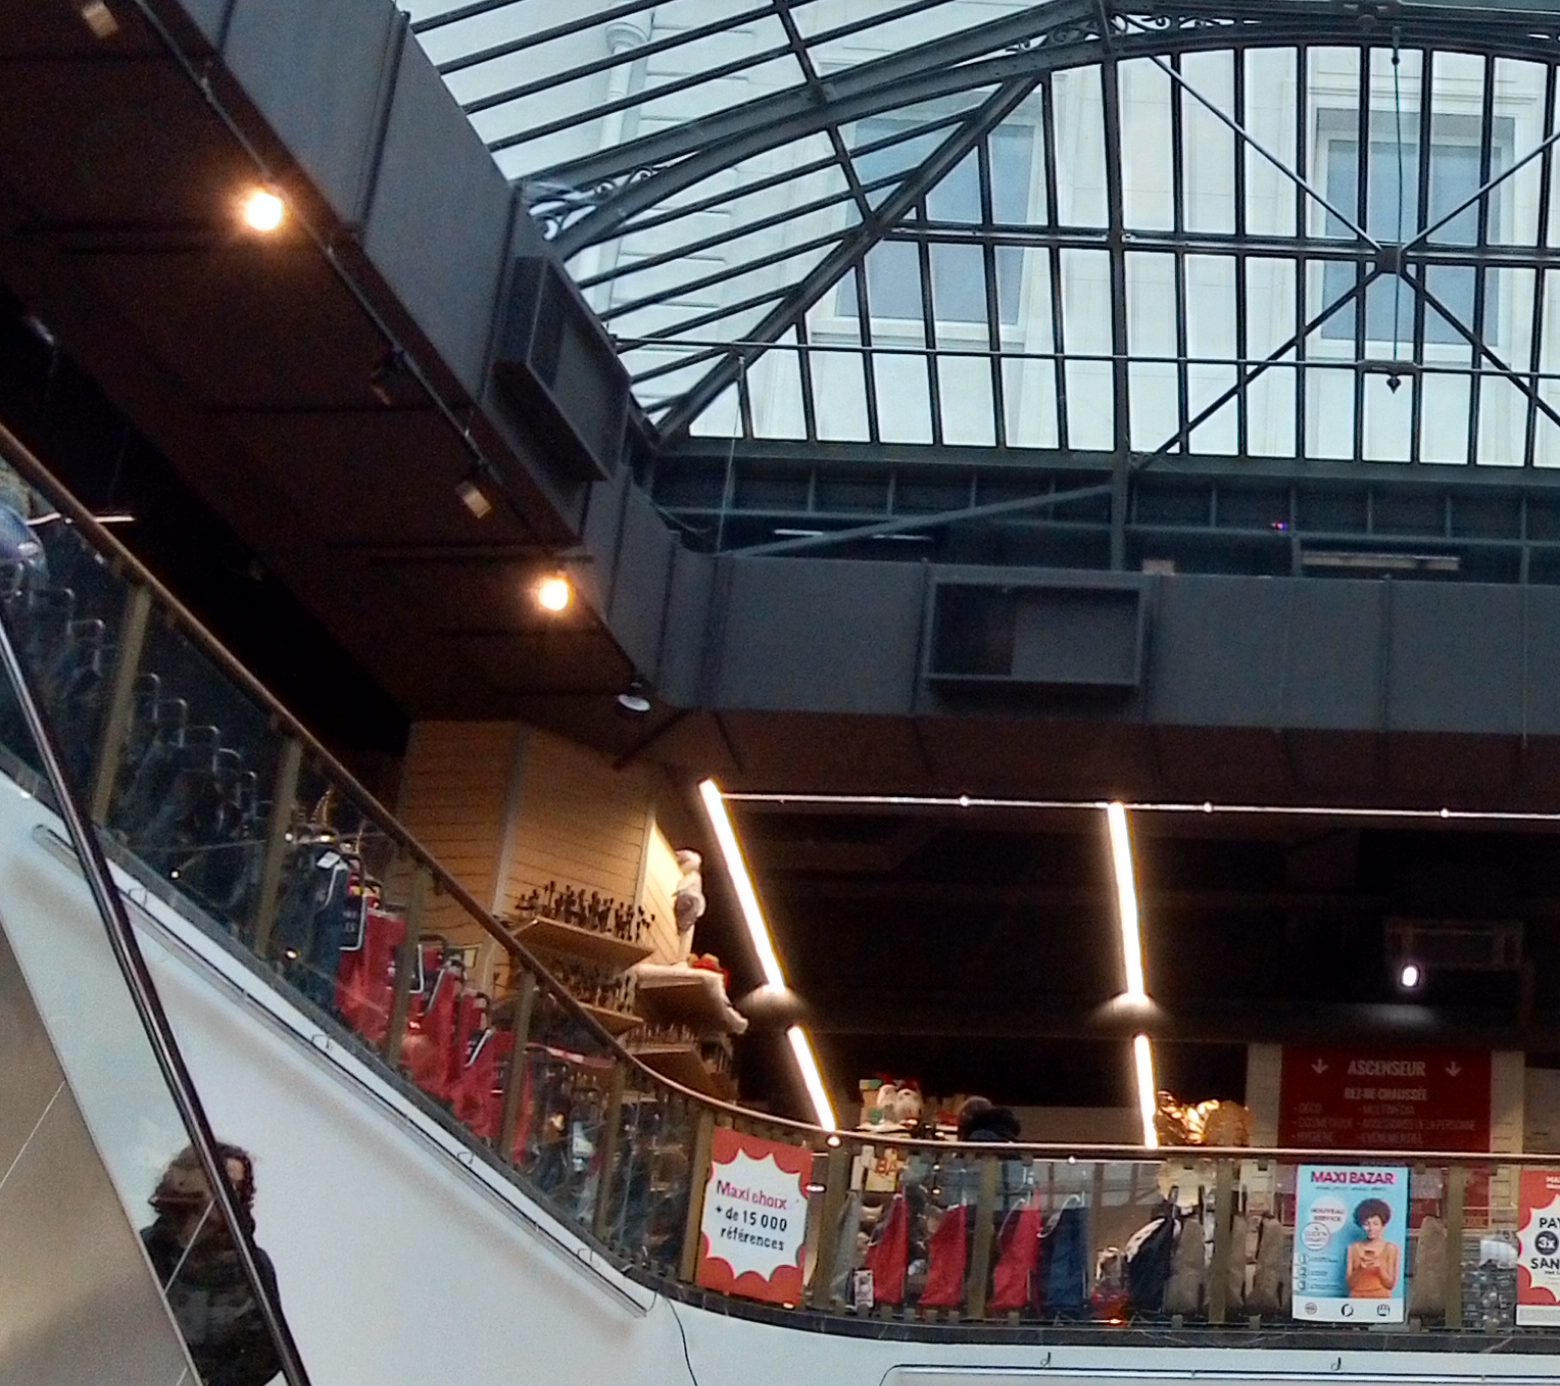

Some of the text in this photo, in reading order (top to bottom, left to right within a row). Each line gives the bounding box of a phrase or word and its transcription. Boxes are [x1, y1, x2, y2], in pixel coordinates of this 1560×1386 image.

[1347, 1059, 1426, 1077] ASCENSEUR
[1311, 1171, 1395, 1184] MAXI BAZAR
[717, 1180, 787, 1210] Maxi choix
[726, 1207, 738, 1221] de
[743, 1211, 757, 1226] 15
[761, 1214, 787, 1231] 000
[720, 1227, 784, 1251] références
[1538, 1236, 1555, 1249] 3x
